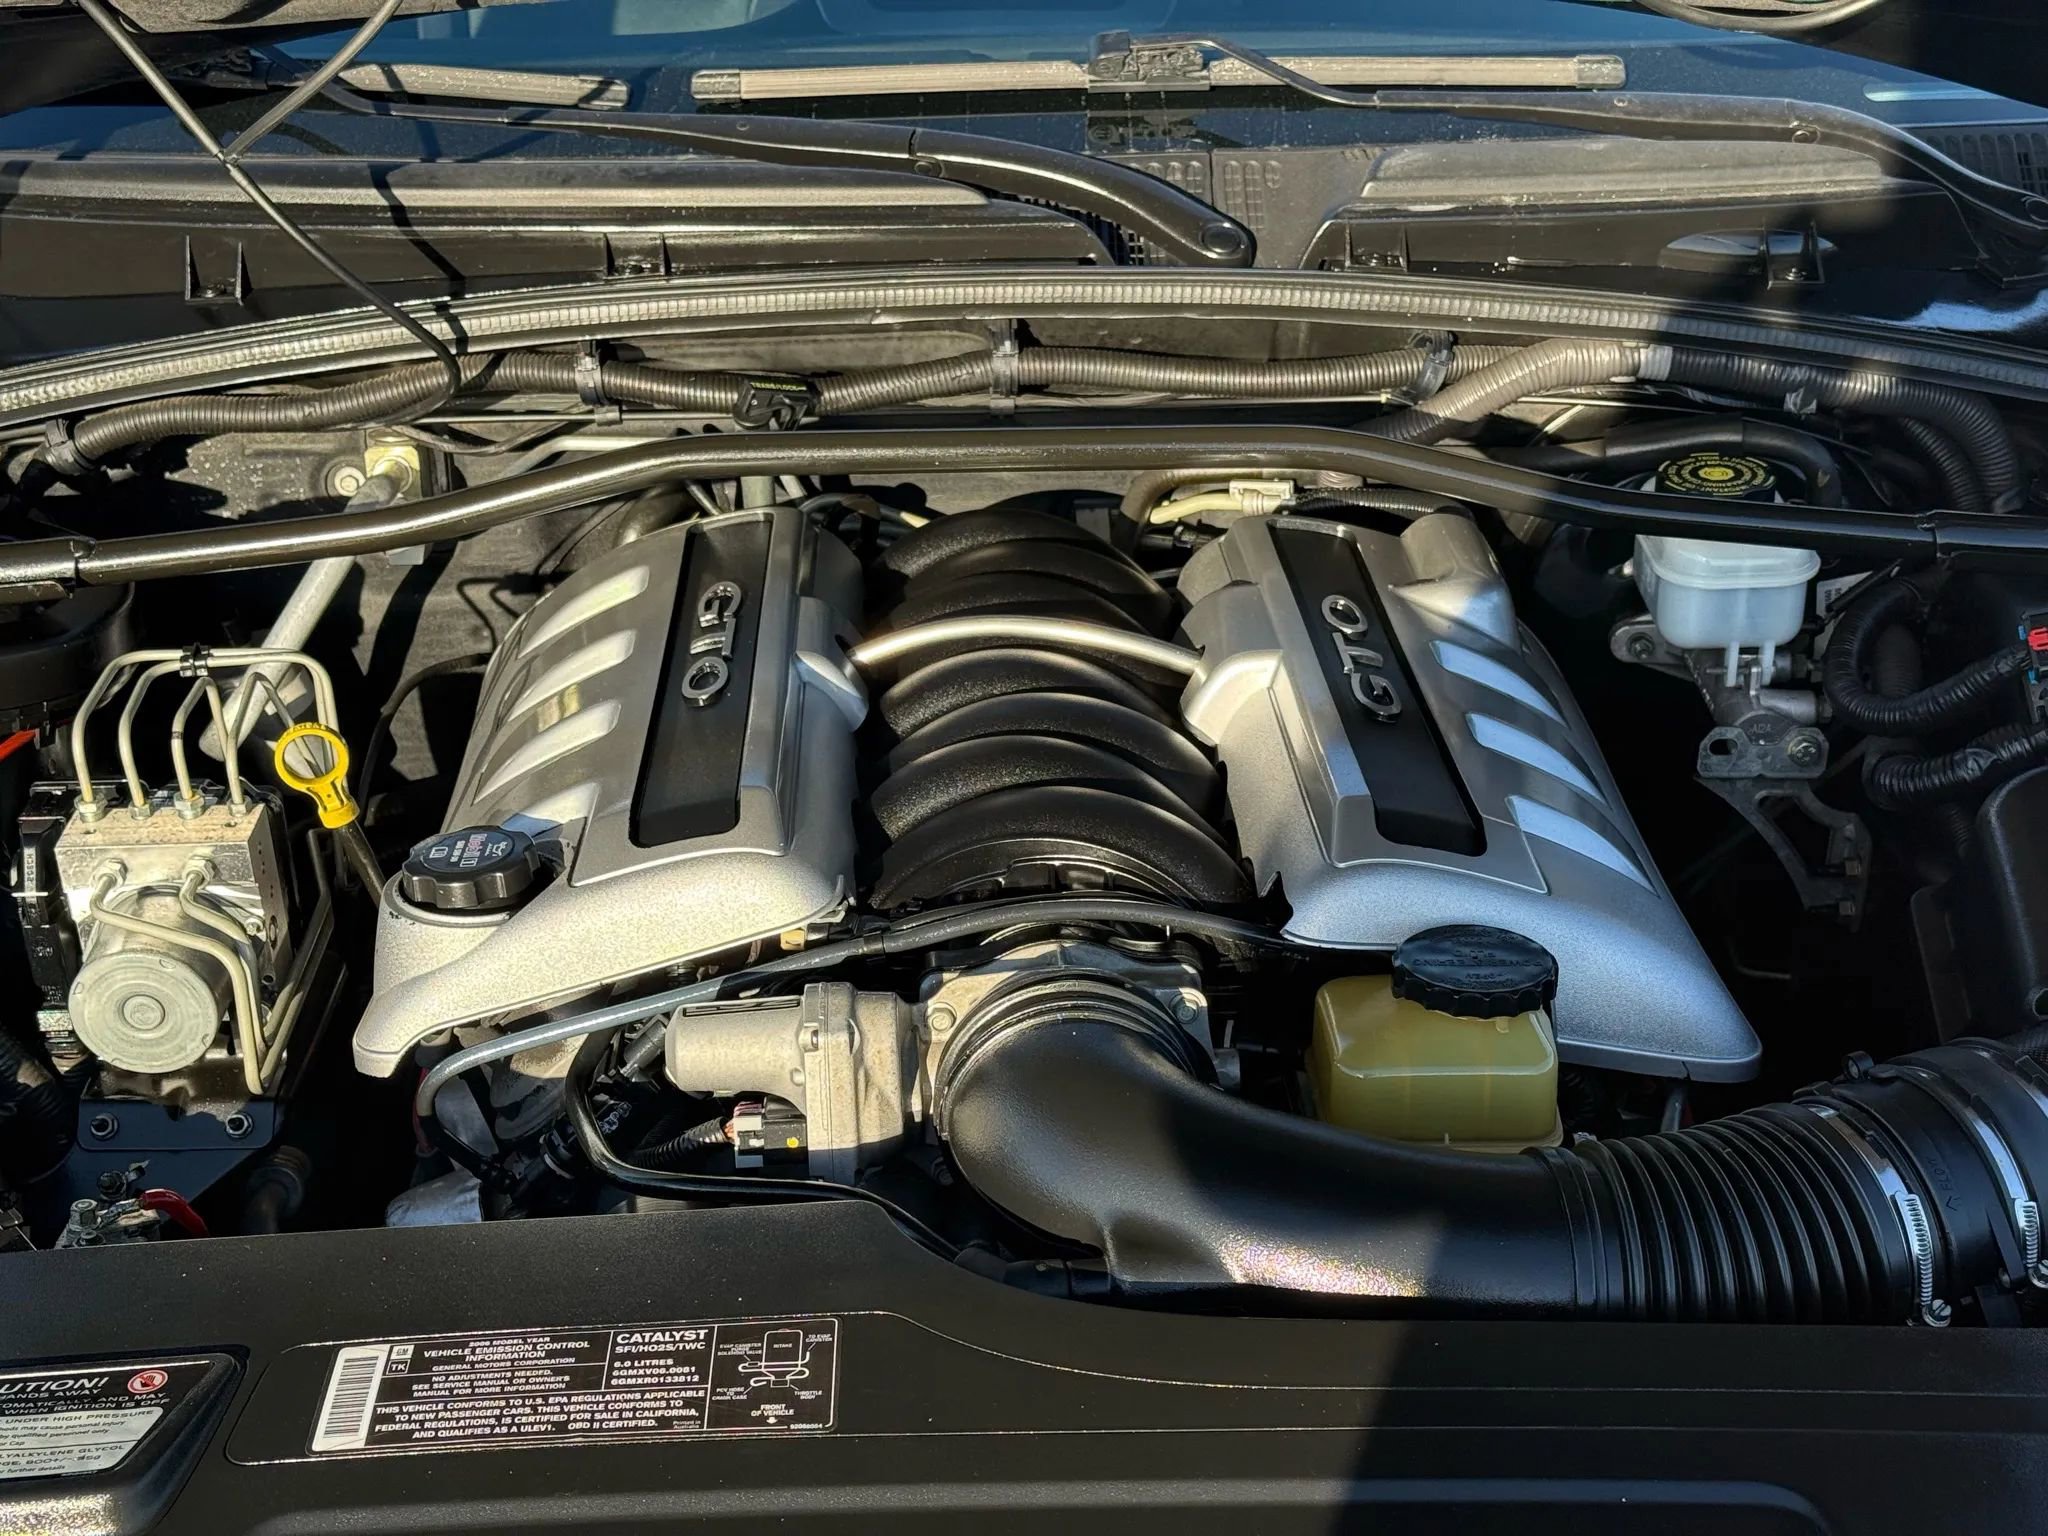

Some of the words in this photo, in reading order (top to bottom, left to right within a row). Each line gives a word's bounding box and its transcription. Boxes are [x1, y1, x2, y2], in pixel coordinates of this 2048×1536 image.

[682, 581, 741, 702] GTO
[1321, 595, 1401, 718] GTO
[616, 1329, 708, 1344] CATALYST
[424, 1348, 472, 1358] VEHICLE
[475, 1345, 532, 1355] EMISSION
[536, 1341, 590, 1351] CONTROL
[615, 1342, 706, 1353] SFI/HO2S/TWC
[465, 1351, 546, 1362] INFORMATION
[614, 1360, 631, 1368] 6.0
[634, 1358, 674, 1367] LITRES
[391, 1363, 406, 1371] TK
[432, 1363, 472, 1371] GENERAL
[474, 1361, 512, 1369] MOTORS
[514, 1357, 575, 1367] CORPORATION
[448, 1371, 512, 1381] ADJUSTMENTS
[514, 1369, 553, 1377] NEEDED.
[412, 1383, 430, 1391] SEE
[433, 1380, 471, 1389] SERVICE
[473, 1378, 509, 1387] MANUAL
[528, 1375, 570, 1383] OWNER'S
[413, 1389, 450, 1397] MANUAL
[453, 1387, 472, 1395] FOR
[474, 1385, 502, 1394] MORE
[503, 1383, 566, 1392] INFORMATION
[0, 1398, 91, 1408] OMATICALLY
[134, 1392, 166, 1400] MAY
[54, 1389, 101, 1397] AWAY
[54, 1402, 116, 1411] IGNITION
[140, 1398, 170, 1406] OFF
[376, 1406, 399, 1415] THIS
[402, 1403, 444, 1413] VEHICLE
[447, 1400, 506, 1409] CONFORMS
[525, 1397, 545, 1405] U.S.
[548, 1396, 569, 1404] EPA
[571, 1393, 641, 1403] REGULATIONS
[643, 1390, 705, 1399] APPLICABLE
[86, 1410, 154, 1420] PRESSURE
[395, 1414, 408, 1422] TO
[411, 1412, 437, 1420] NEW
[438, 1409, 500, 1419] PASSENGER
[503, 1407, 534, 1415] CARS.
[537, 1405, 561, 1413] THIS
[563, 1403, 605, 1412] VEHICLE
[607, 1401, 667, 1410] CONFORMS
[65, 1422, 101, 1430] personal
[375, 1423, 421, 1432] FEDERAL
[424, 1418, 498, 1429] REGULATIONS,
[514, 1414, 567, 1424] CERTIFIED
[570, 1413, 591, 1421] FOR
[594, 1411, 620, 1420] SALE
[635, 1408, 699, 1418] CALIFORNIA,
[49, 1430, 90, 1438] personnel
[412, 1431, 435, 1439] AND
[437, 1427, 491, 1438] QUALIFIES
[493, 1426, 508, 1434] AS
[510, 1425, 518, 1433] A
[568, 1422, 591, 1430] OBD
[593, 1421, 600, 1429] II
[602, 1419, 658, 1429] CERTIFIED.
[78, 1444, 125, 1454] GLYCOL
